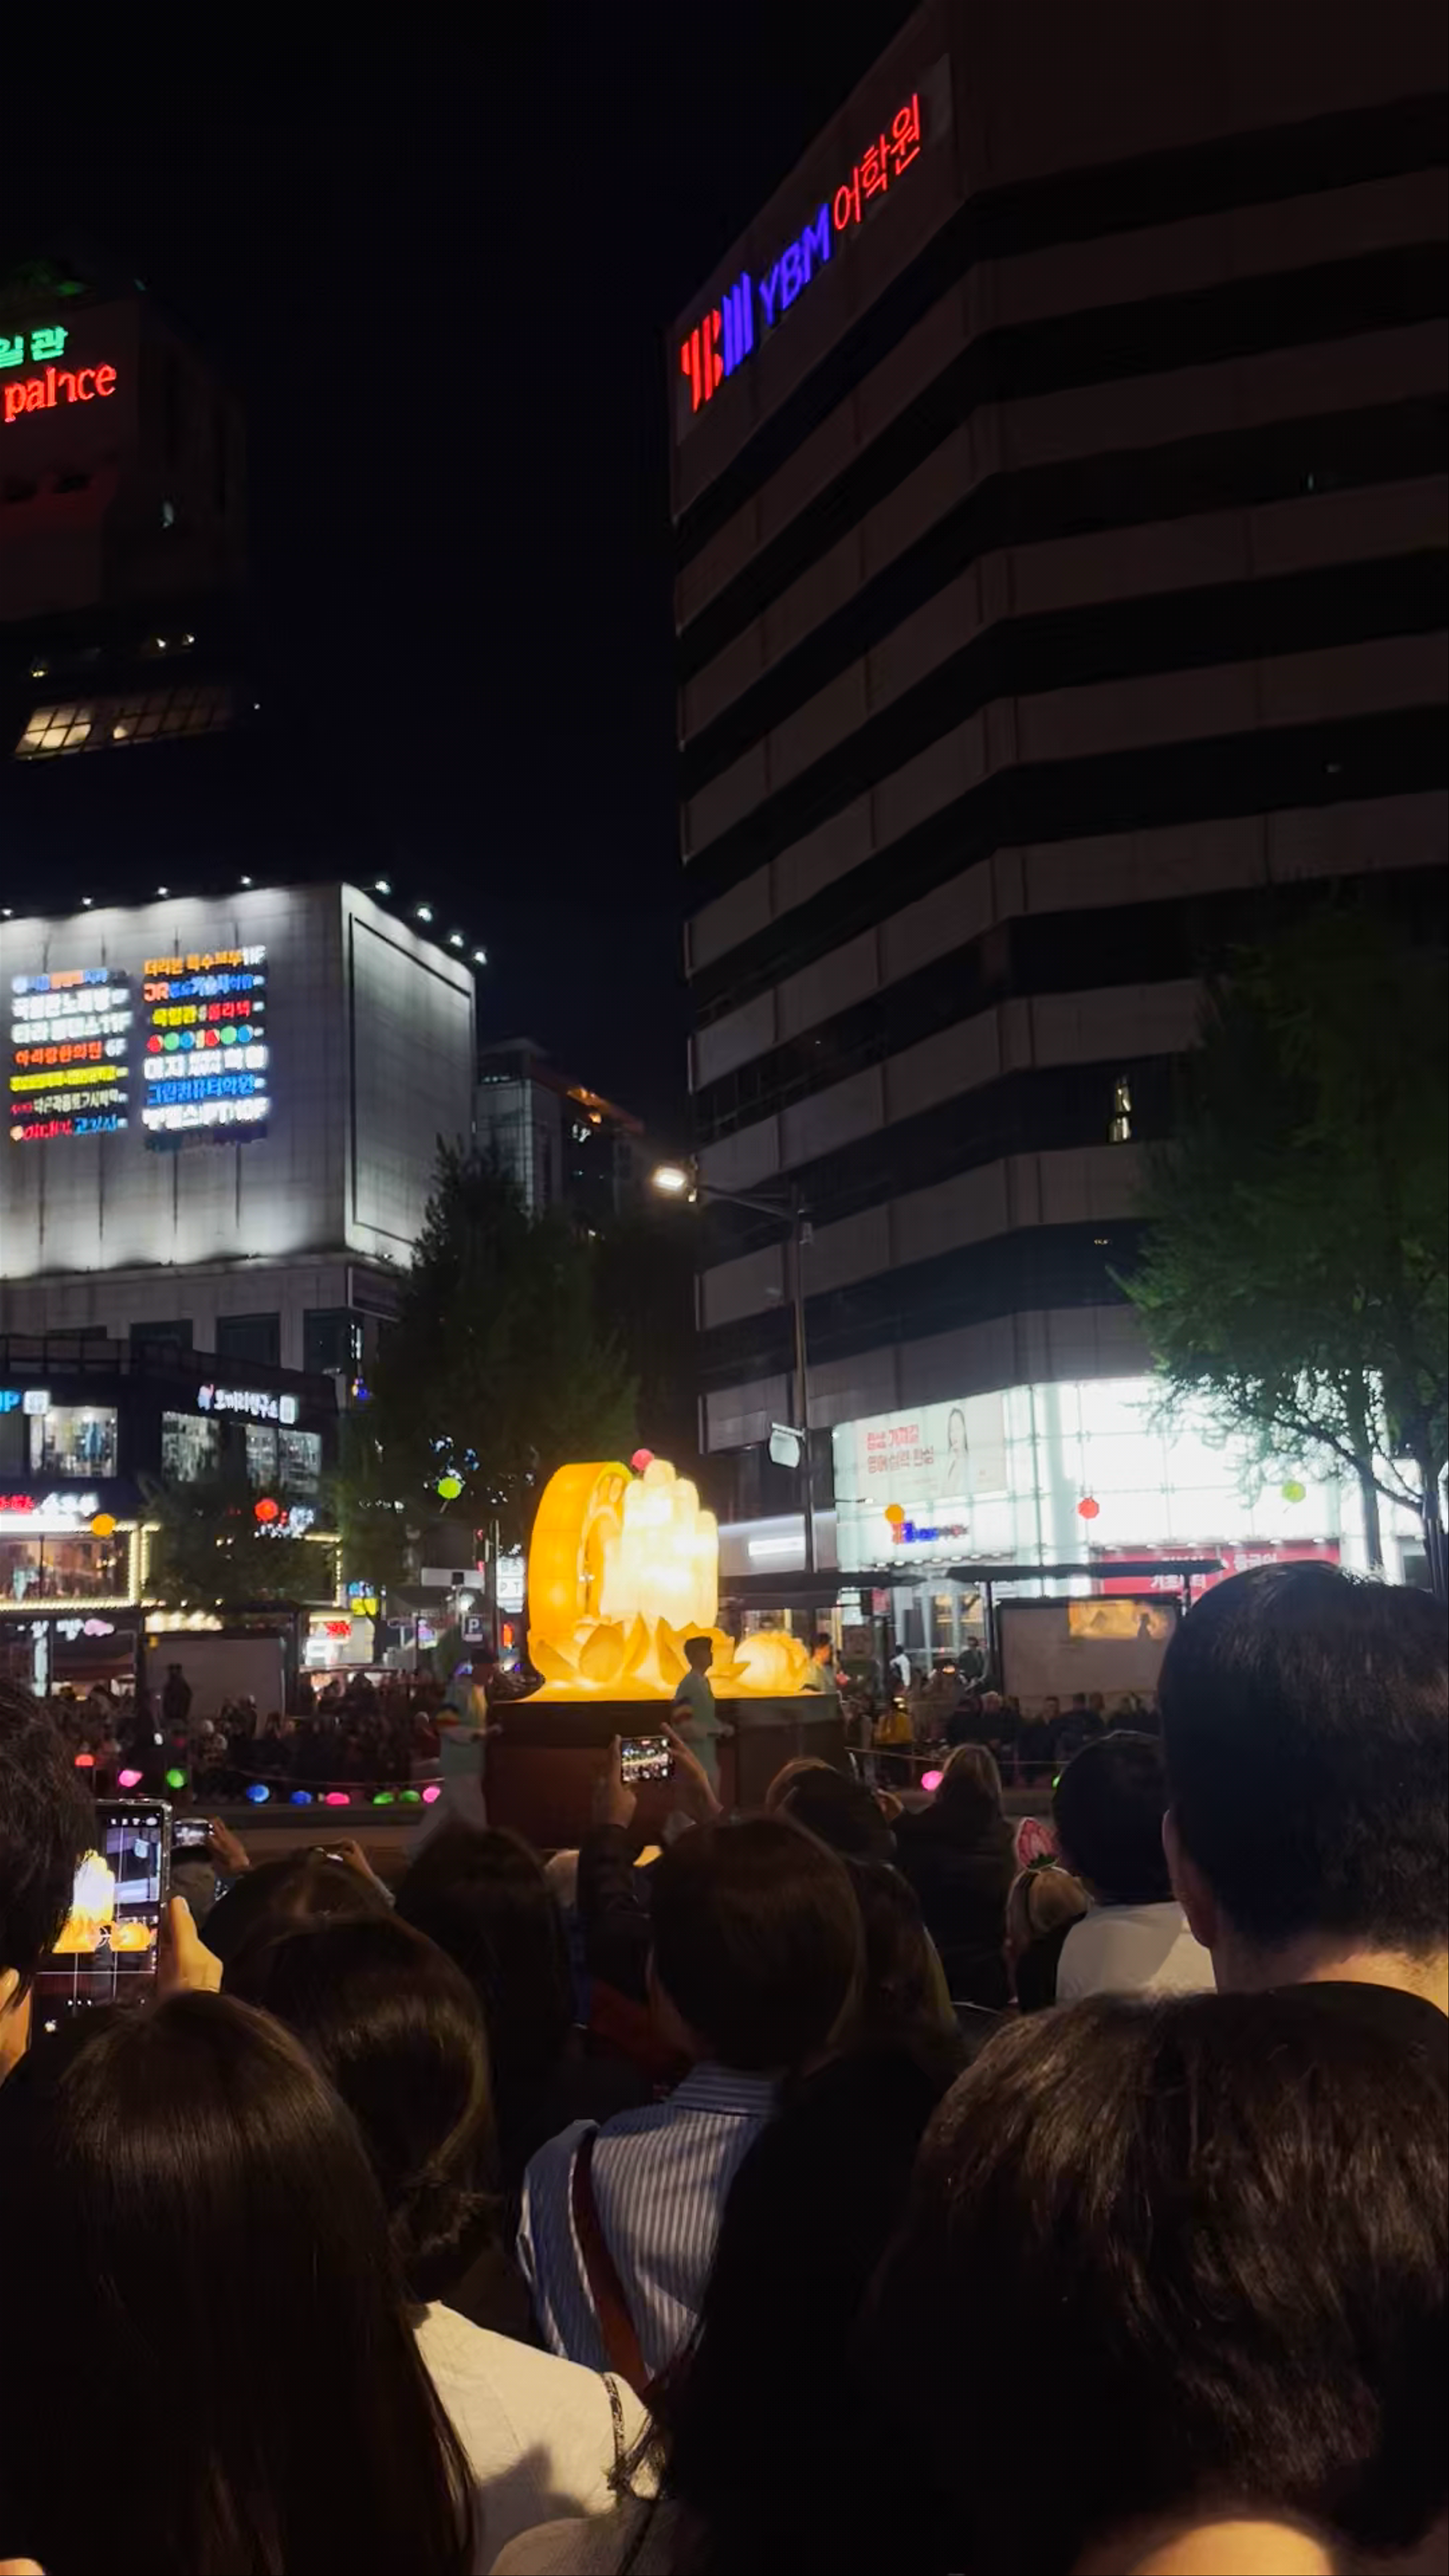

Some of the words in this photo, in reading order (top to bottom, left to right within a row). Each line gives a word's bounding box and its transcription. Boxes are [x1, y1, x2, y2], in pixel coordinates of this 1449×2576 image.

[834, 93, 921, 231] 어학원
[1150, 1574, 1207, 1589] 기초터
[469, 1618, 479, 1632] P
